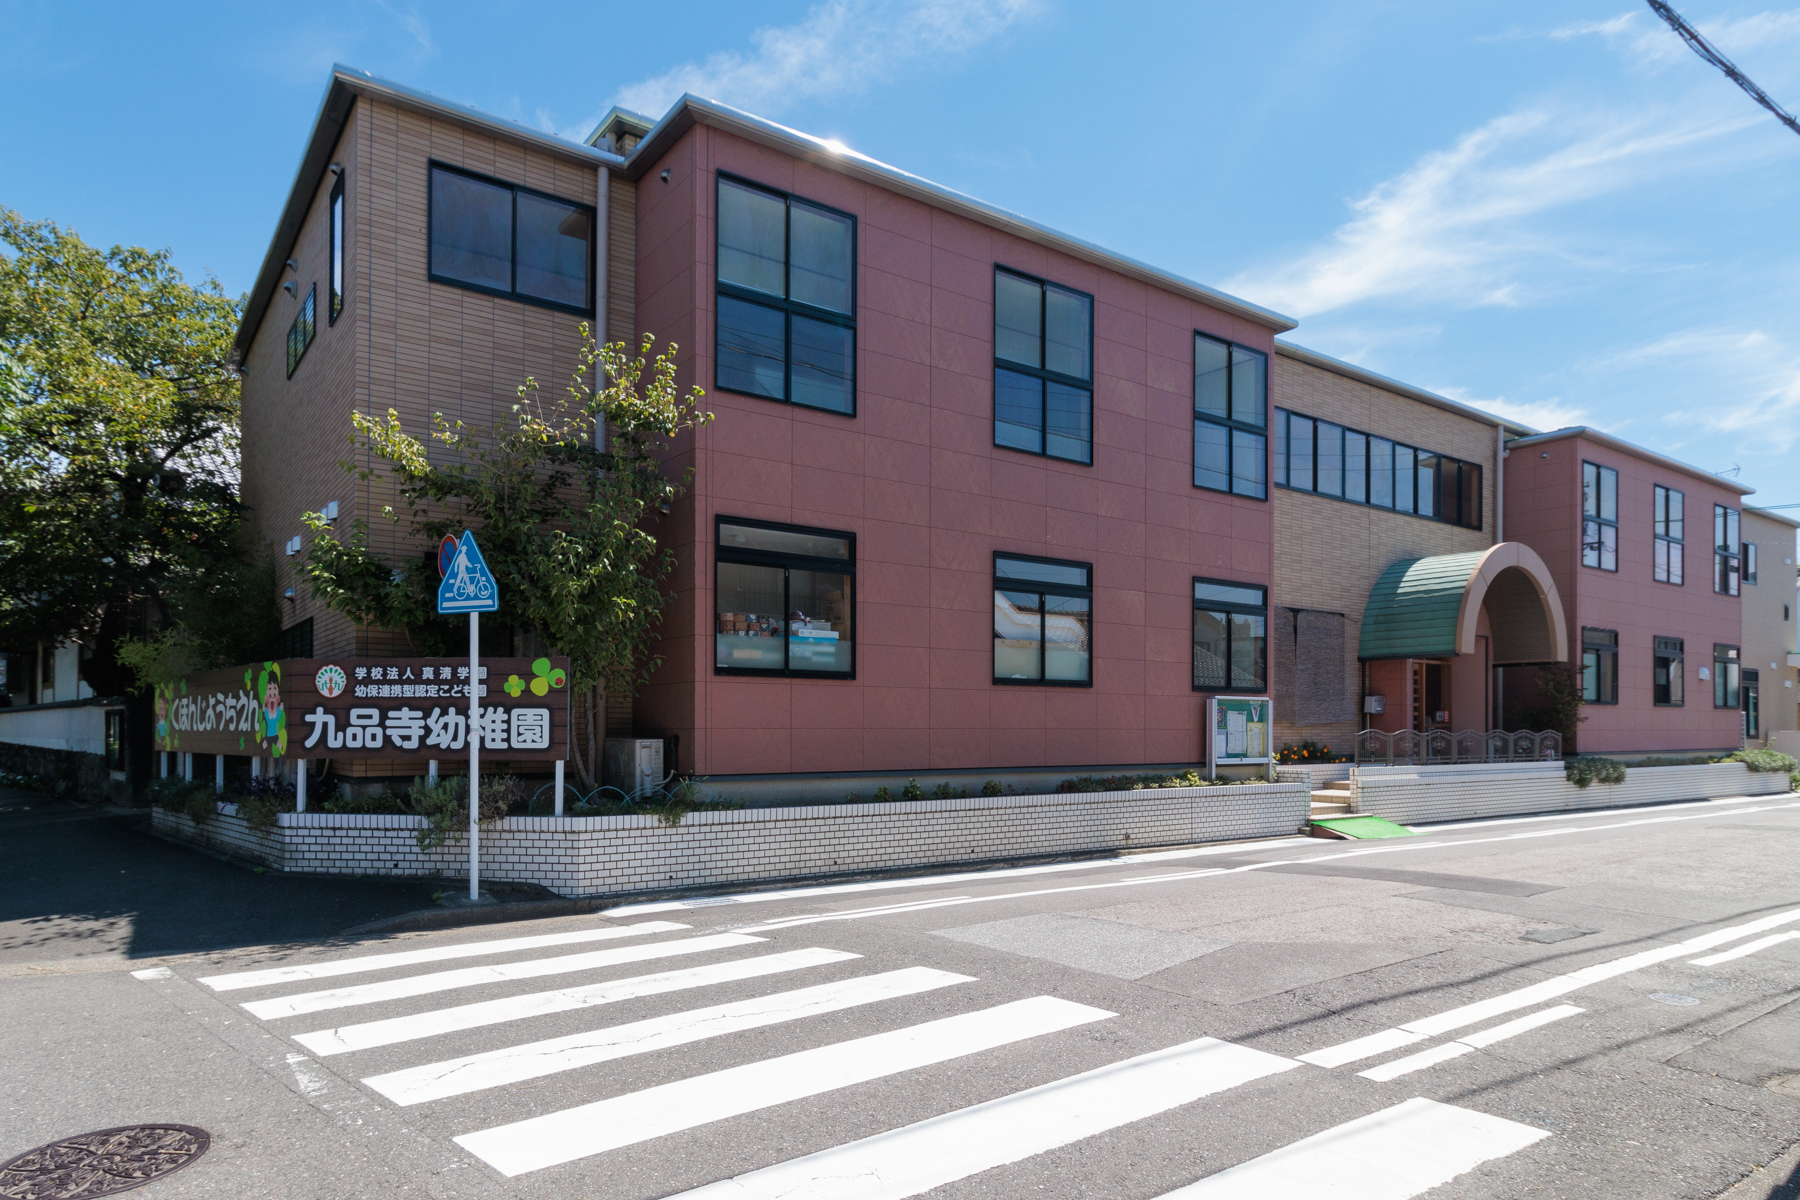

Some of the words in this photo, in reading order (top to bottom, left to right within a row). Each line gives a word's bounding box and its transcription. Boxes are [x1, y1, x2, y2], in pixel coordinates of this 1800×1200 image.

[354, 684, 487, 697] 幼保連携型認定こども園
[304, 707, 550, 750] 九品寺幼稚園
